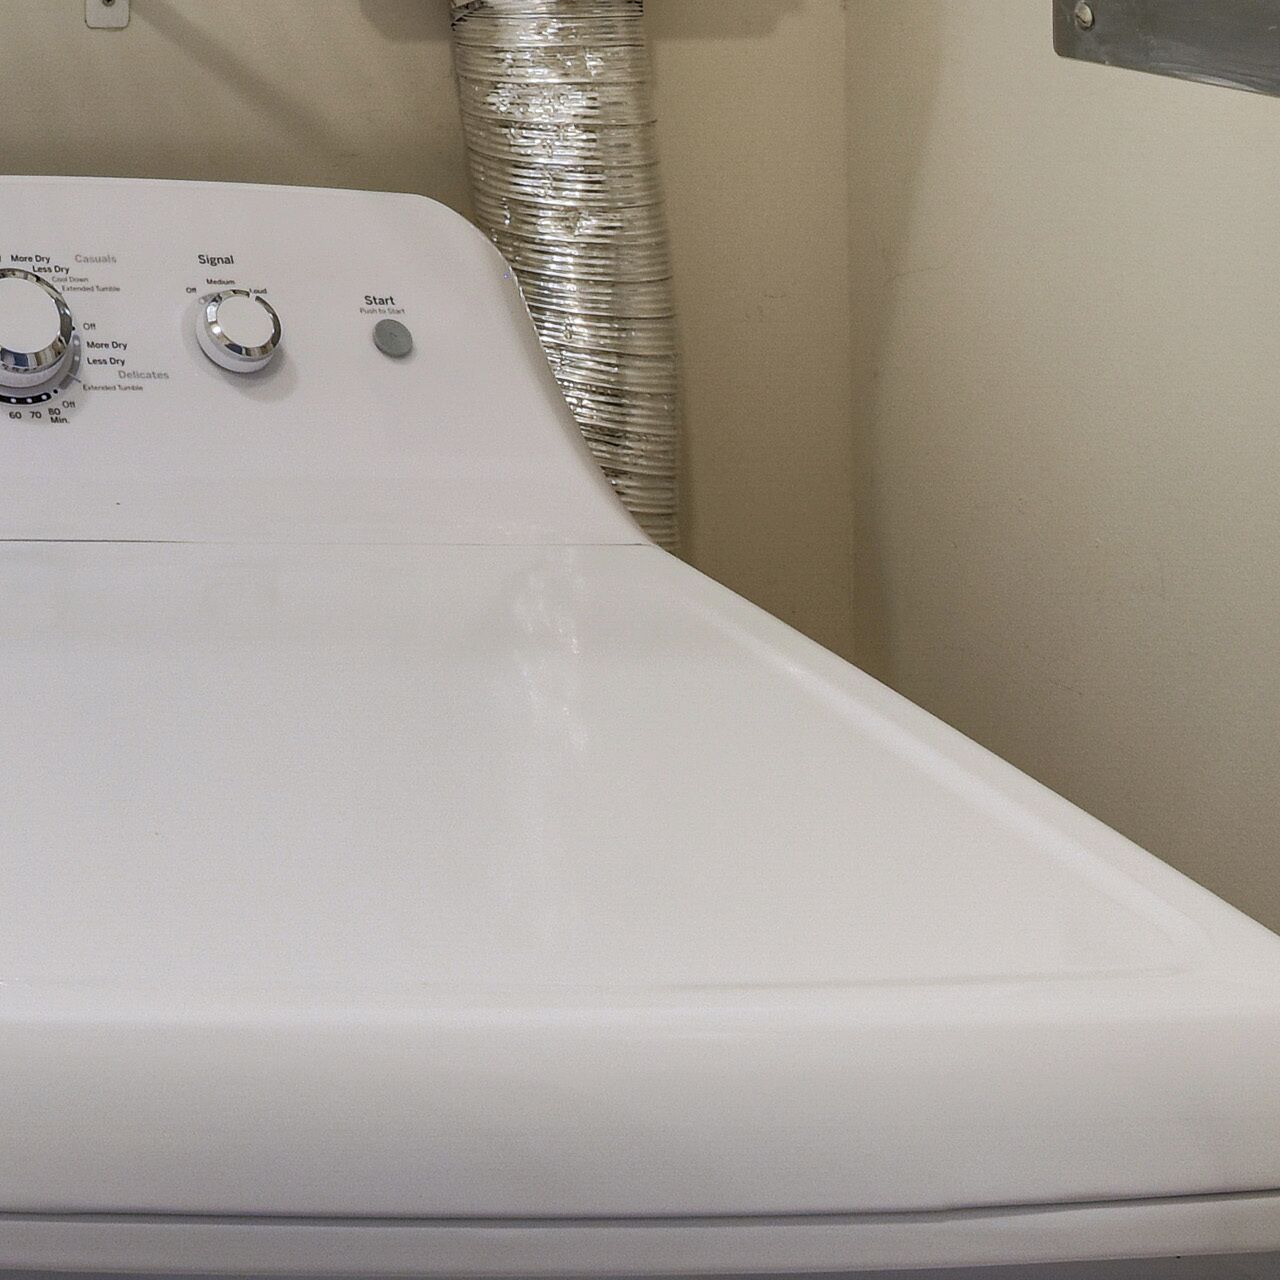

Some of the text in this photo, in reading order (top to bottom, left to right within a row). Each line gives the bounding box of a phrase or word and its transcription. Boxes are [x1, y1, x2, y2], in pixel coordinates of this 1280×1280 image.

[10, 255, 51, 264] More Dry
[74, 255, 117, 263] Casuals
[197, 254, 234, 267] Signal
[54, 266, 70, 275] Dry
[364, 295, 395, 306] Start
[83, 323, 96, 331] Off
[86, 341, 128, 351] More Dry
[87, 357, 125, 366] Less Dry
[118, 371, 170, 380] Delicates
[62, 400, 75, 408] Off
[9, 411, 22, 419] 60
[30, 411, 42, 419] 70
[48, 408, 61, 416] 80
[50, 416, 70, 424] Min.
